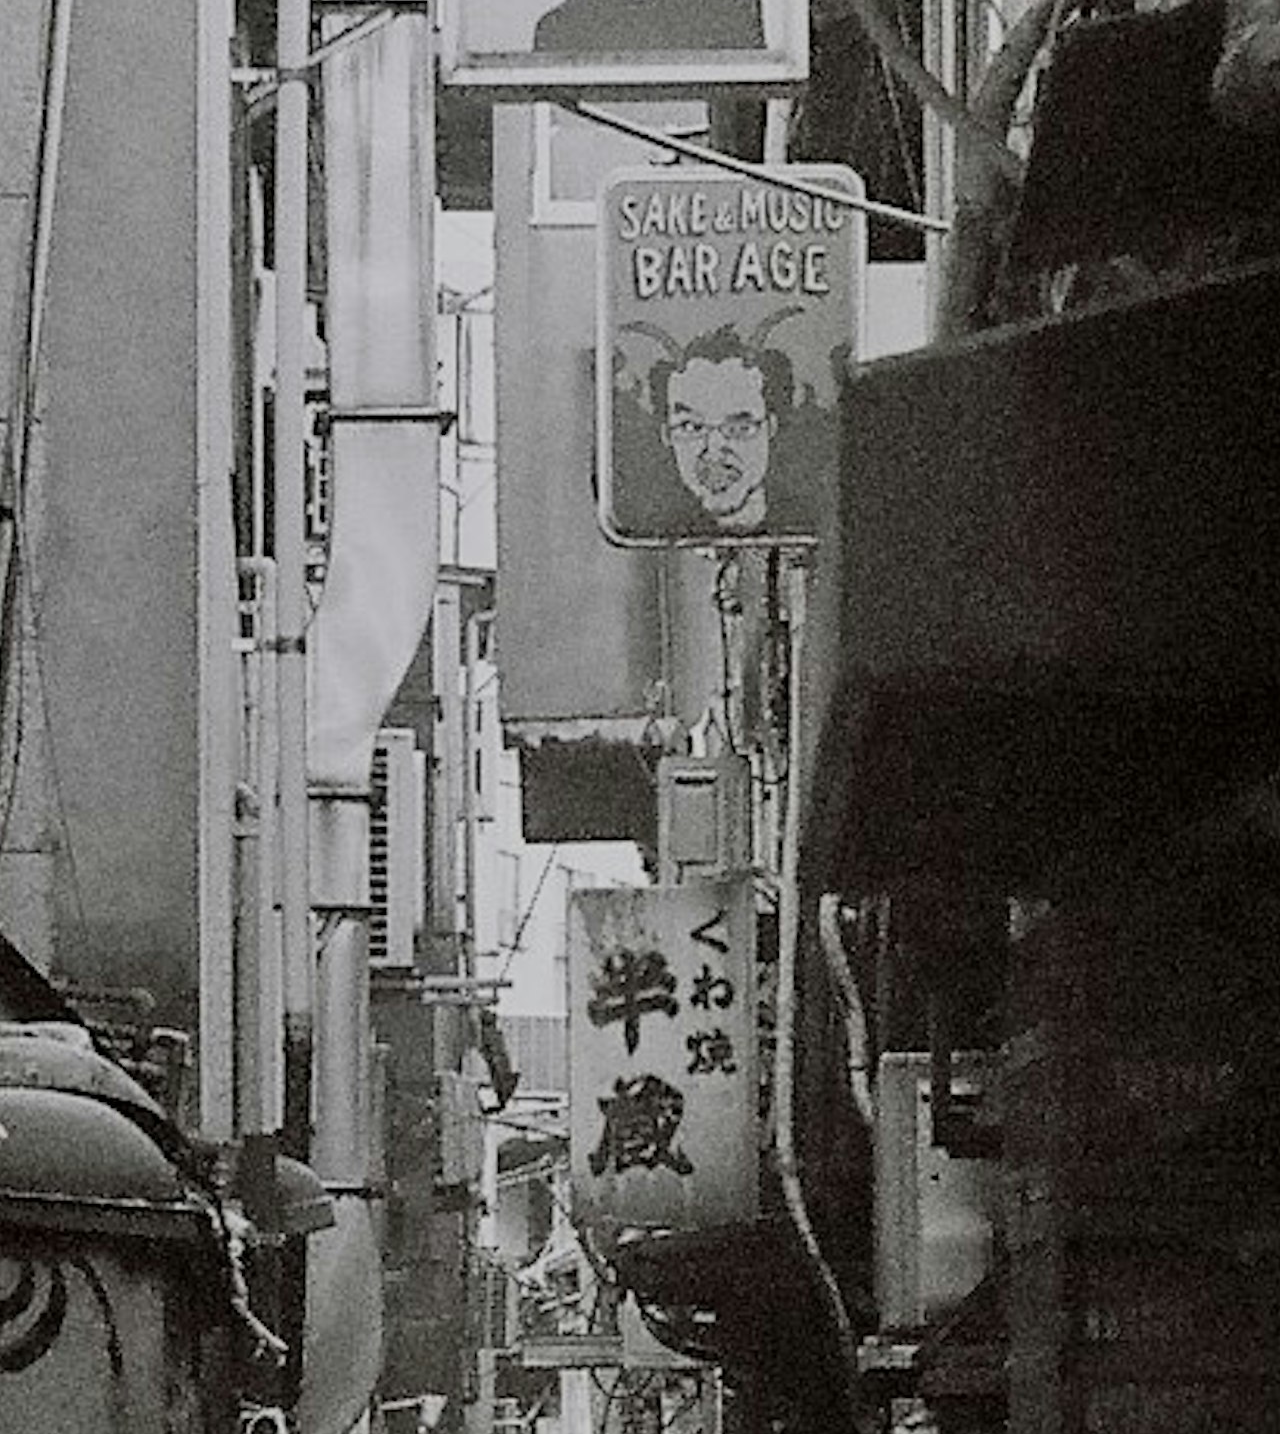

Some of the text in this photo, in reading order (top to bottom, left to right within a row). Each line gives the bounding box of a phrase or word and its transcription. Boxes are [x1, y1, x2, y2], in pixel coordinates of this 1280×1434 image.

[619, 187, 847, 242] SAKE & MUSIC
[633, 240, 831, 299] BAR AGE
[686, 908, 737, 1077] くわ焼
